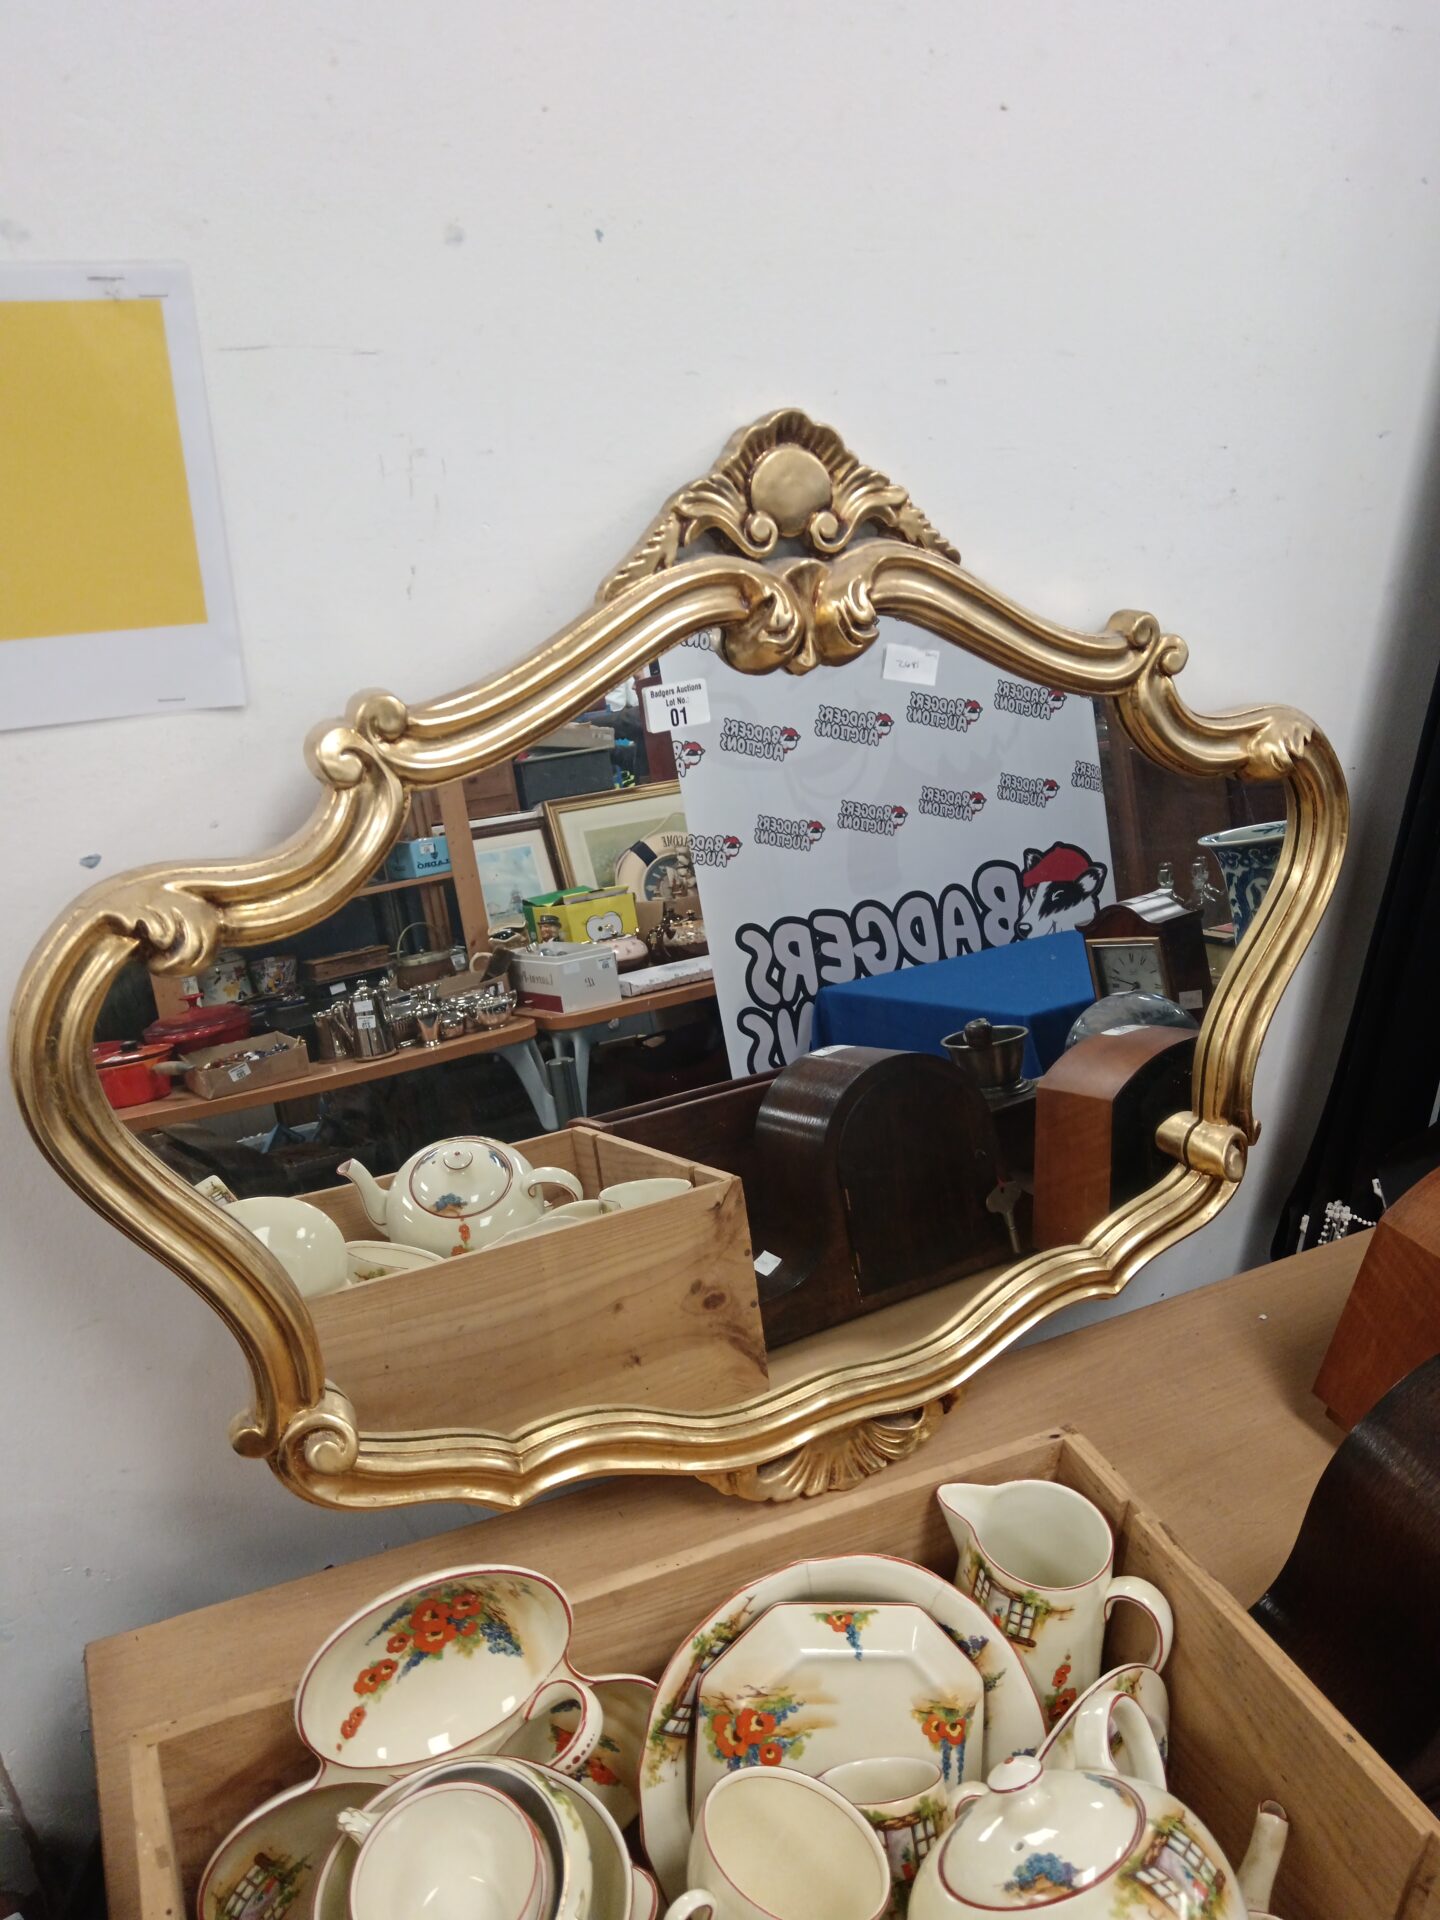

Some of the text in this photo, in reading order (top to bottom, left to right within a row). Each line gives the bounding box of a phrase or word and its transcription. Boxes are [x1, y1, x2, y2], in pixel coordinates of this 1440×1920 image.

[650, 683, 702, 699] Badgers Auctions
[665, 698, 676, 707] Lot
[670, 706, 688, 727] 01
